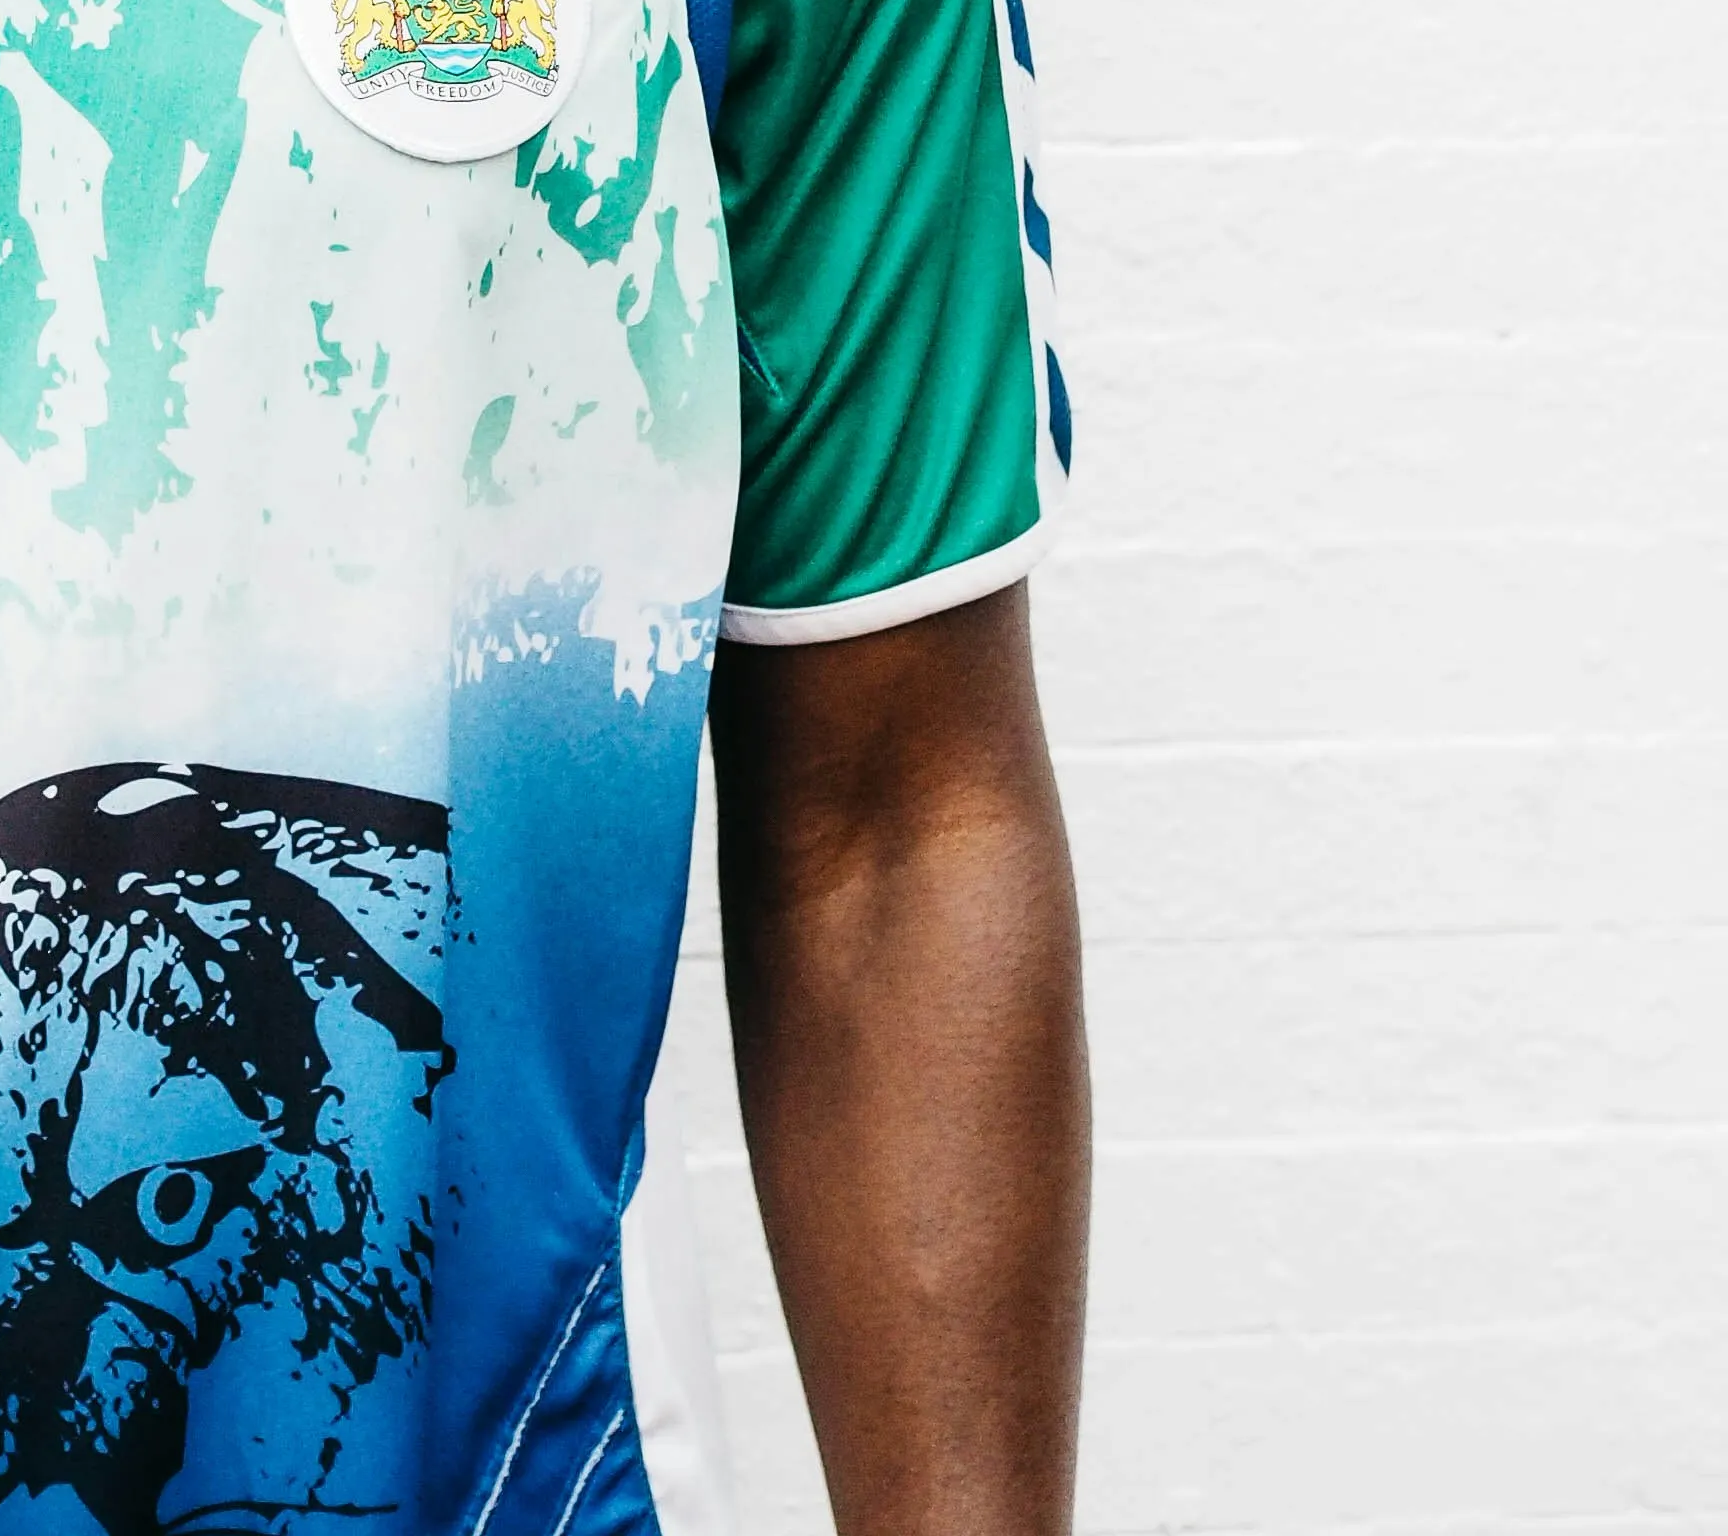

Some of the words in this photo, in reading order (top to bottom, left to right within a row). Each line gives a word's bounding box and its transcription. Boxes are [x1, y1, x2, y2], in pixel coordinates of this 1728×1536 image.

[358, 66, 409, 96] UNITY
[415, 80, 497, 99] FREEDOM
[503, 67, 552, 95] JUSTICE
